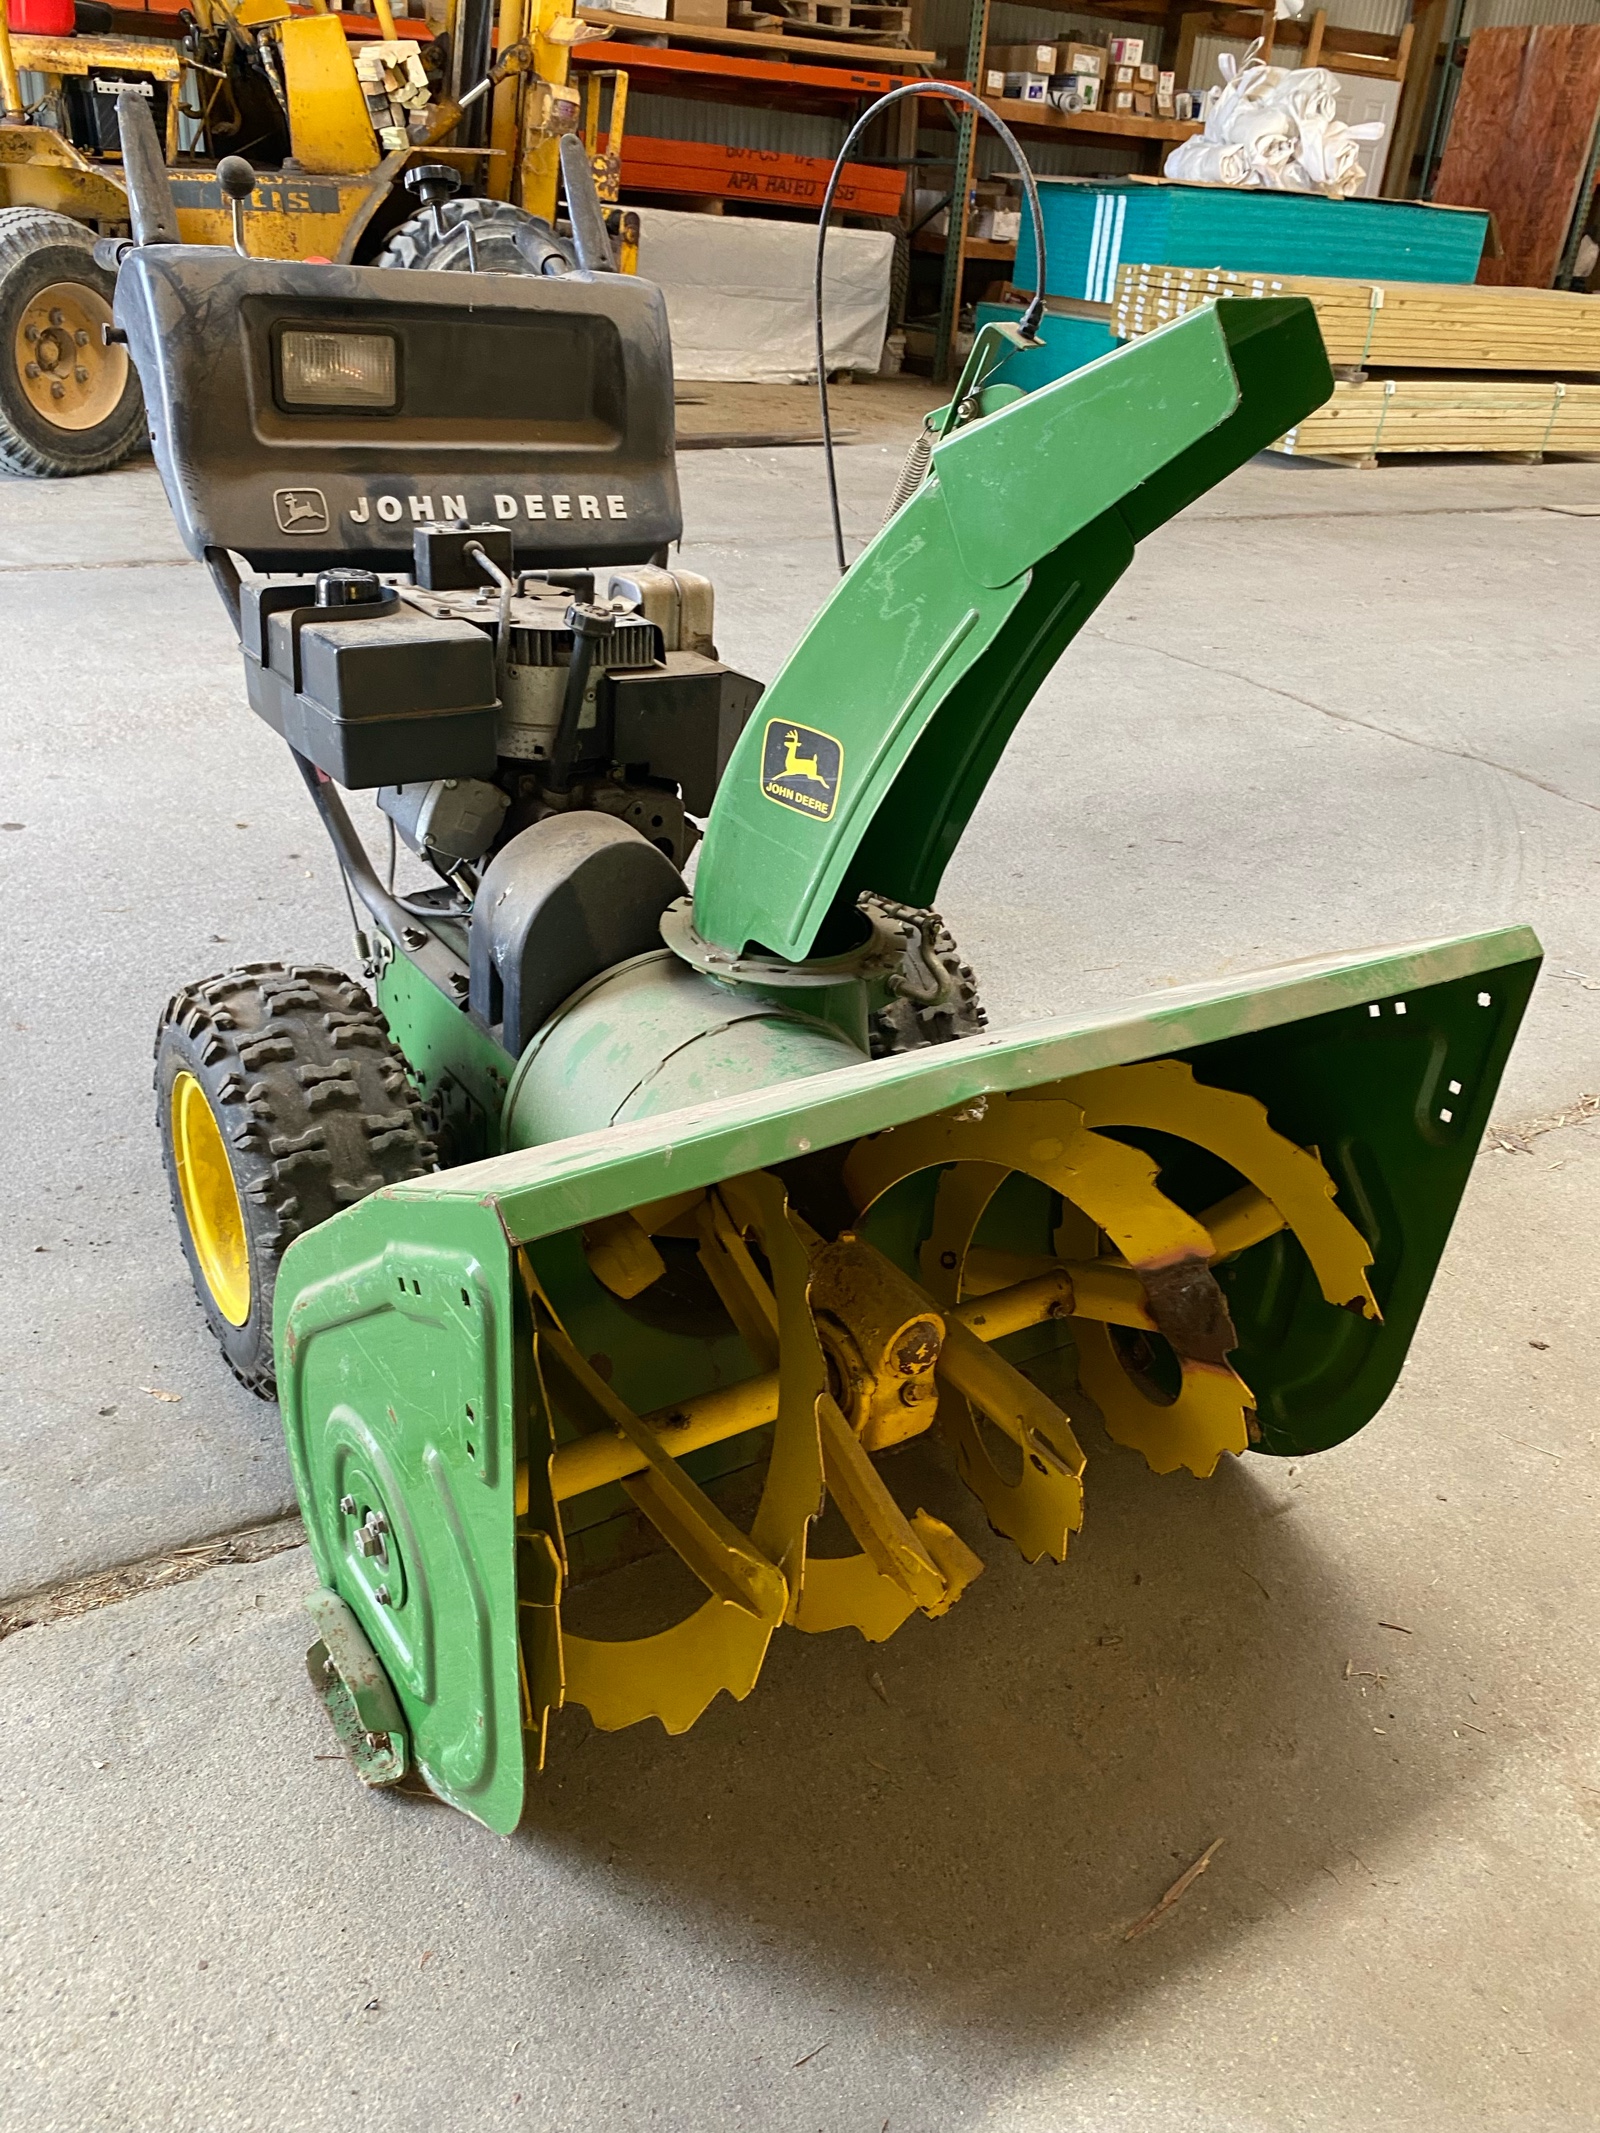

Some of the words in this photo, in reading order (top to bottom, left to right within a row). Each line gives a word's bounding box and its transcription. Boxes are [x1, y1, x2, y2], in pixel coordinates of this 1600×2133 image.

[727, 172, 758, 191] APA
[766, 176, 816, 197] RATED
[350, 495, 468, 523] JOHN
[494, 494, 628, 521] DEERE
[765, 782, 795, 800] JOHN
[795, 792, 829, 814] DEERE
